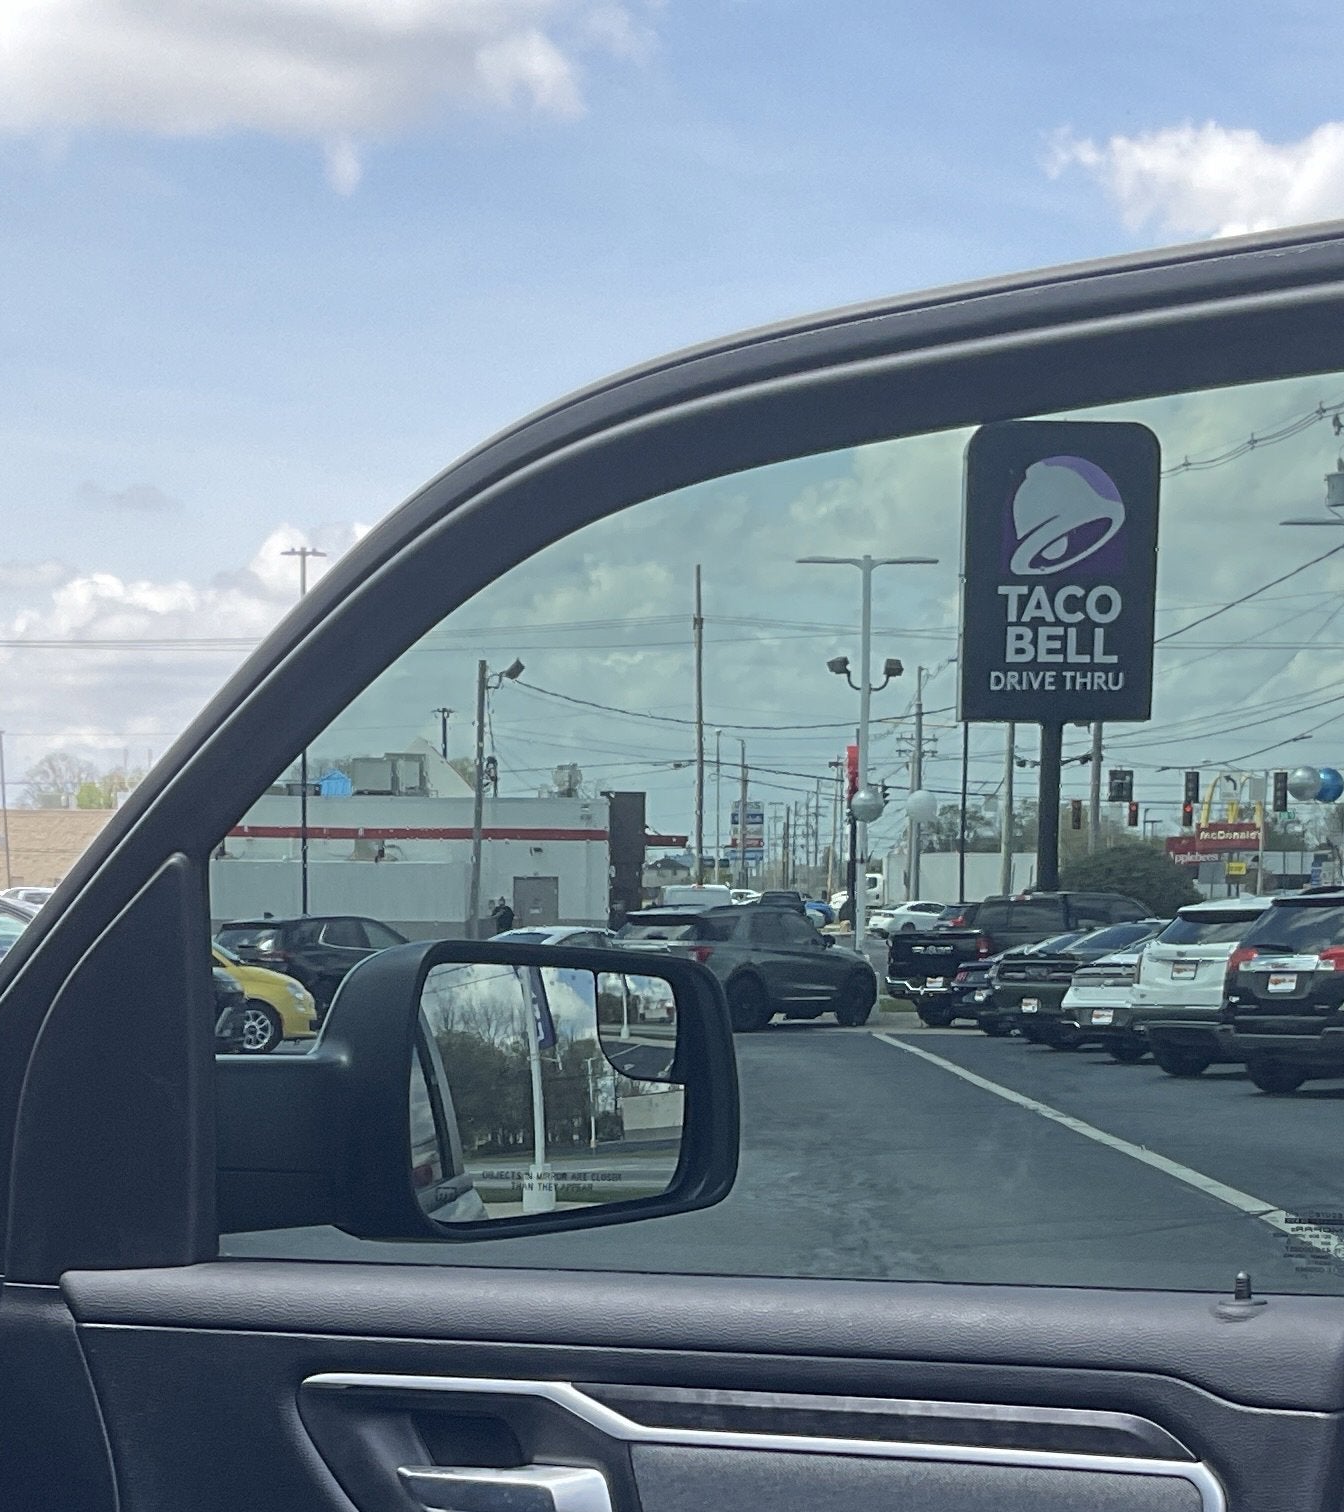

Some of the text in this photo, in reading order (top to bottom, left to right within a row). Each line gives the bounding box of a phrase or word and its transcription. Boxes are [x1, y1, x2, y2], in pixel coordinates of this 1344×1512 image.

[997, 585, 1123, 624] TACO
[1005, 625, 1118, 664] BELL
[989, 671, 1124, 692] DRIVE THRU
